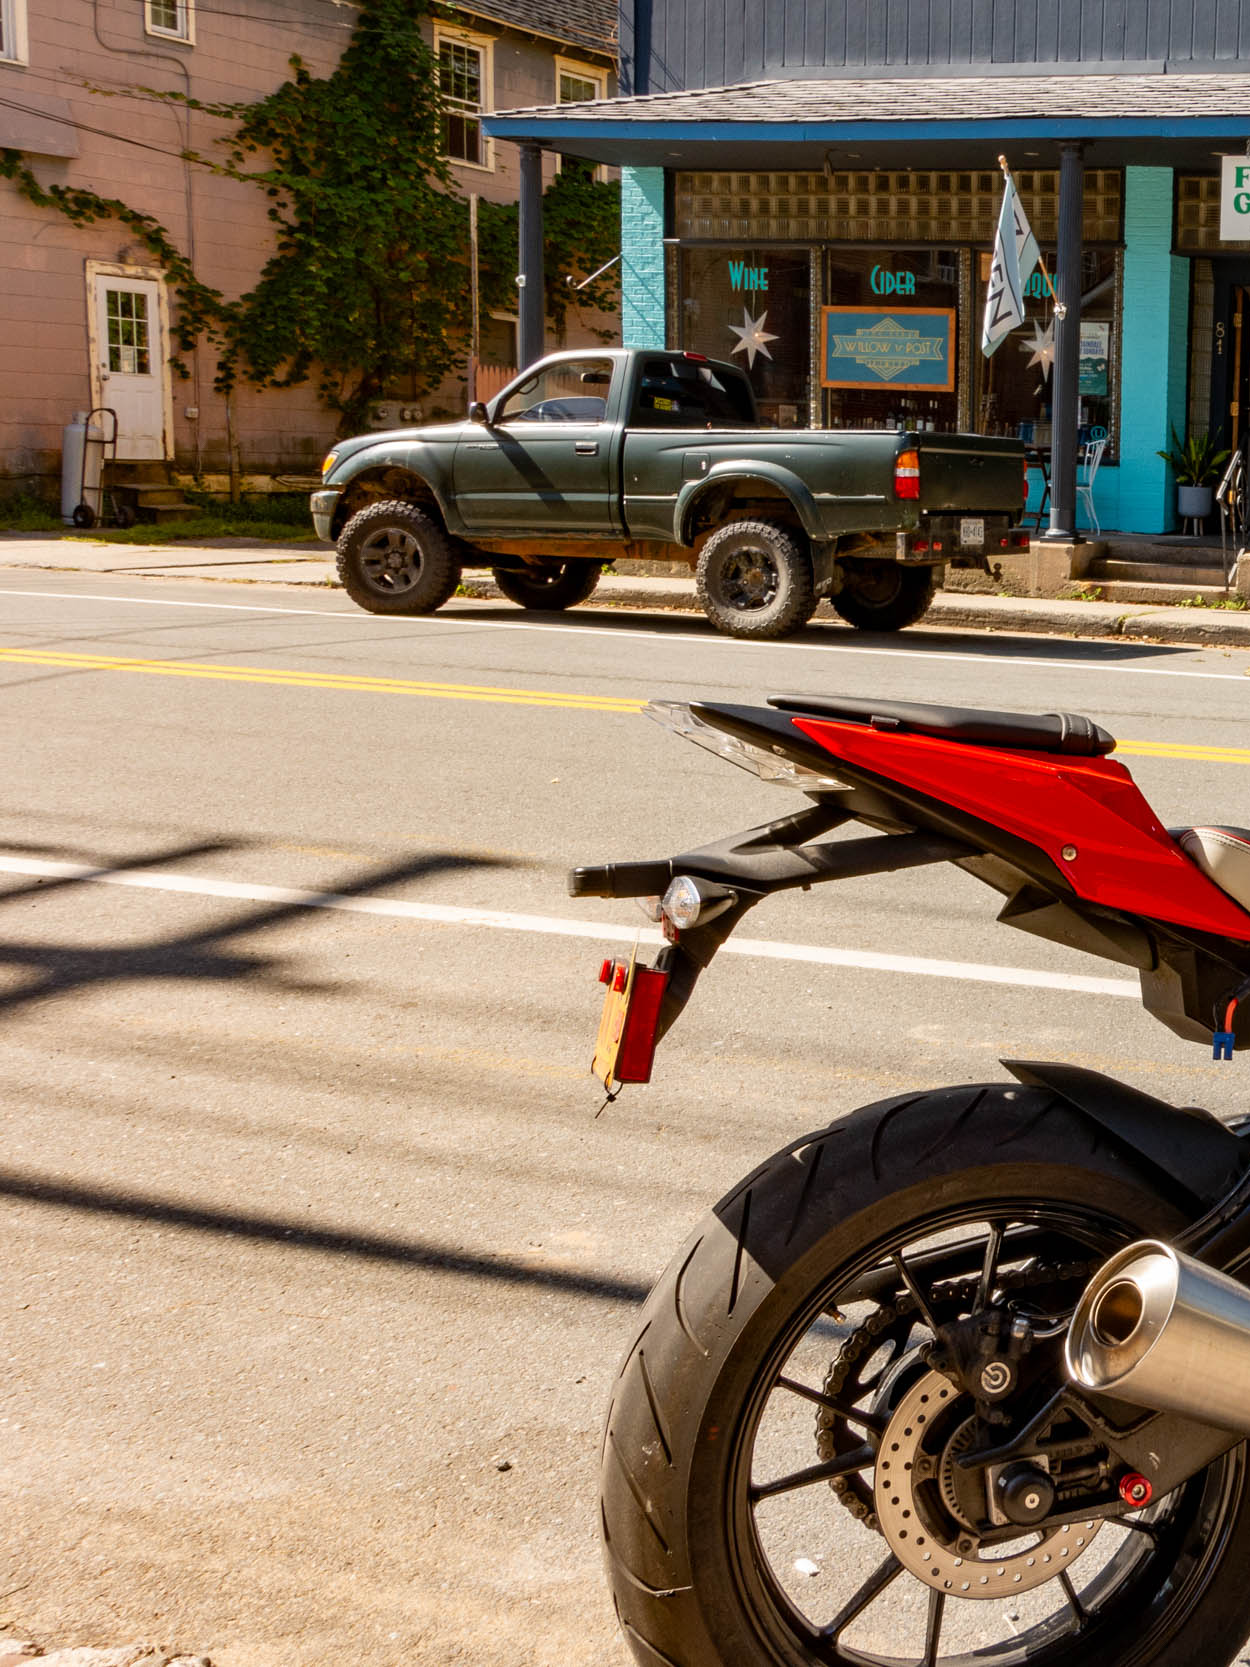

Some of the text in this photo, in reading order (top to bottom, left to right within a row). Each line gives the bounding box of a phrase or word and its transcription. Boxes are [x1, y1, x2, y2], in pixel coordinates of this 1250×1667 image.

[728, 261, 768, 291] WINE
[870, 265, 915, 295] CIDER
[843, 341, 891, 353] WILLOW
[905, 342, 932, 354] POST
